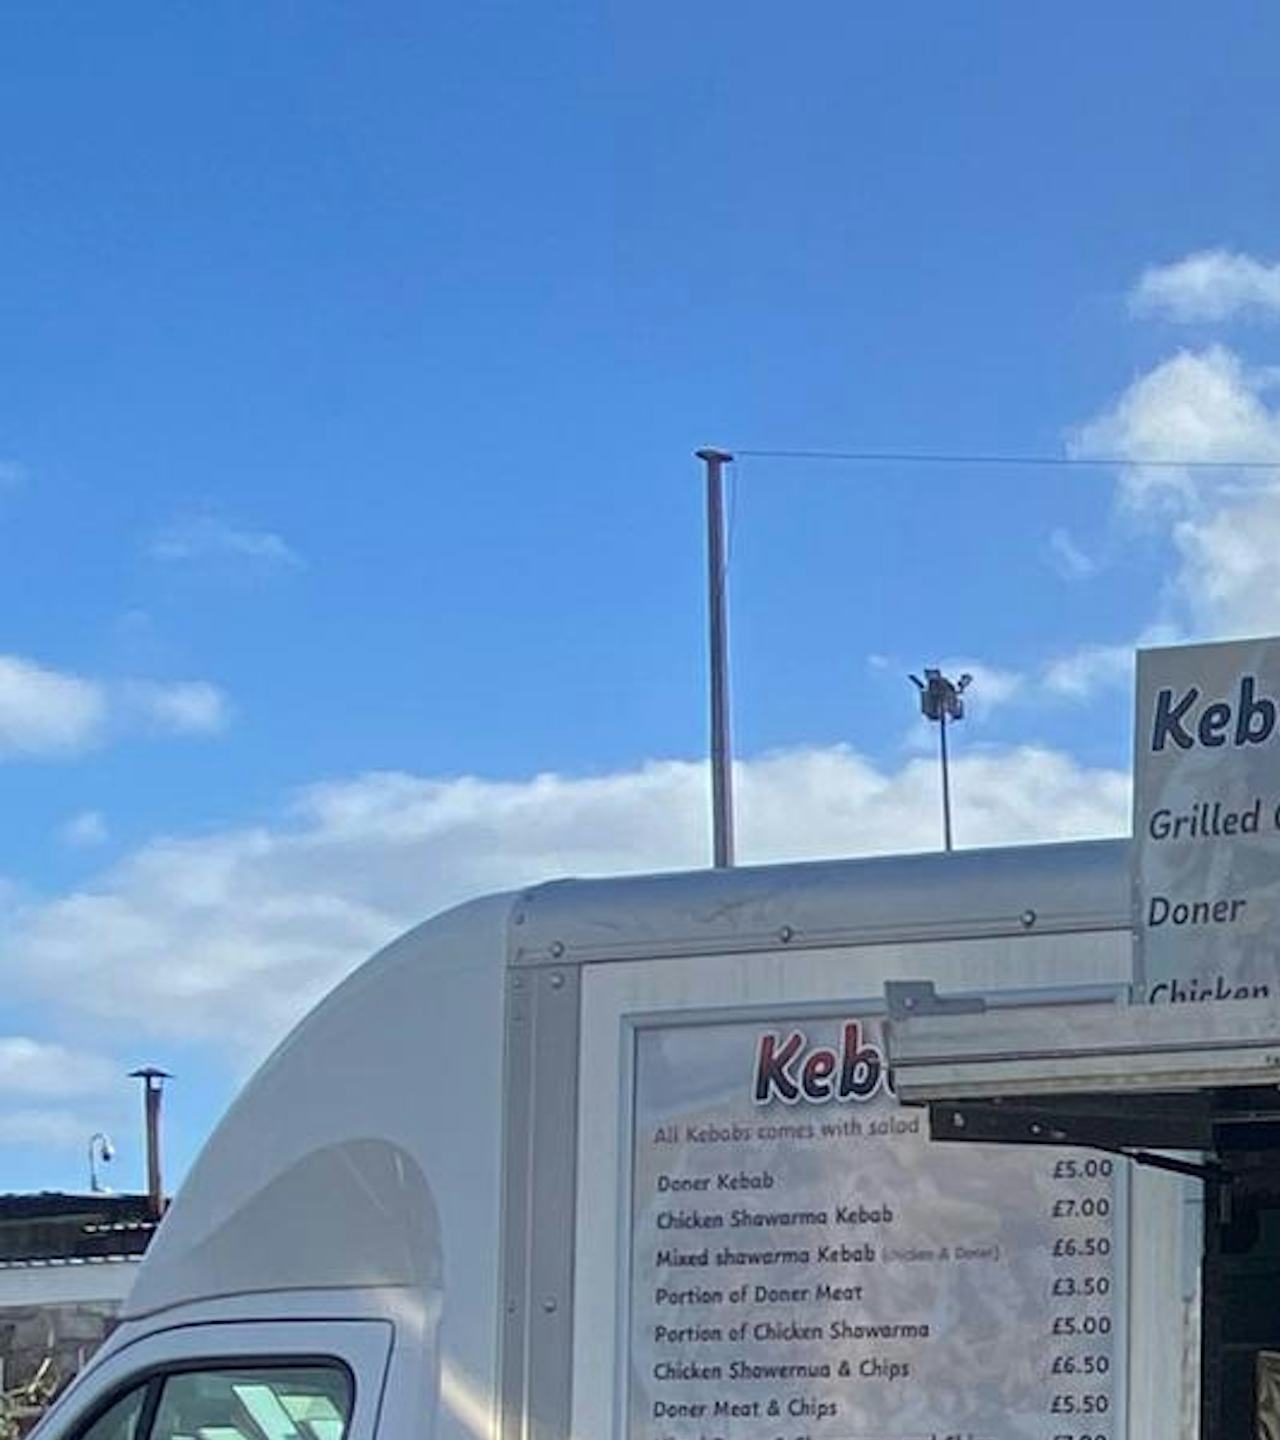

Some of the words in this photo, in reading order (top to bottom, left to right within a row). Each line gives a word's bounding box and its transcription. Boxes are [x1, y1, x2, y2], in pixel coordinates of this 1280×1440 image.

[1148, 800, 1259, 841] Grilled
[1148, 896, 1245, 927] Doner
[1052, 1159, 1113, 1179] £5.00
[657, 1174, 711, 1192] Doner
[717, 1172, 774, 1189] Kebab
[657, 1210, 724, 1230] Chicken
[730, 1208, 827, 1226] Shawarma
[835, 1205, 893, 1224] Kebab
[1052, 1199, 1109, 1217] £7.00
